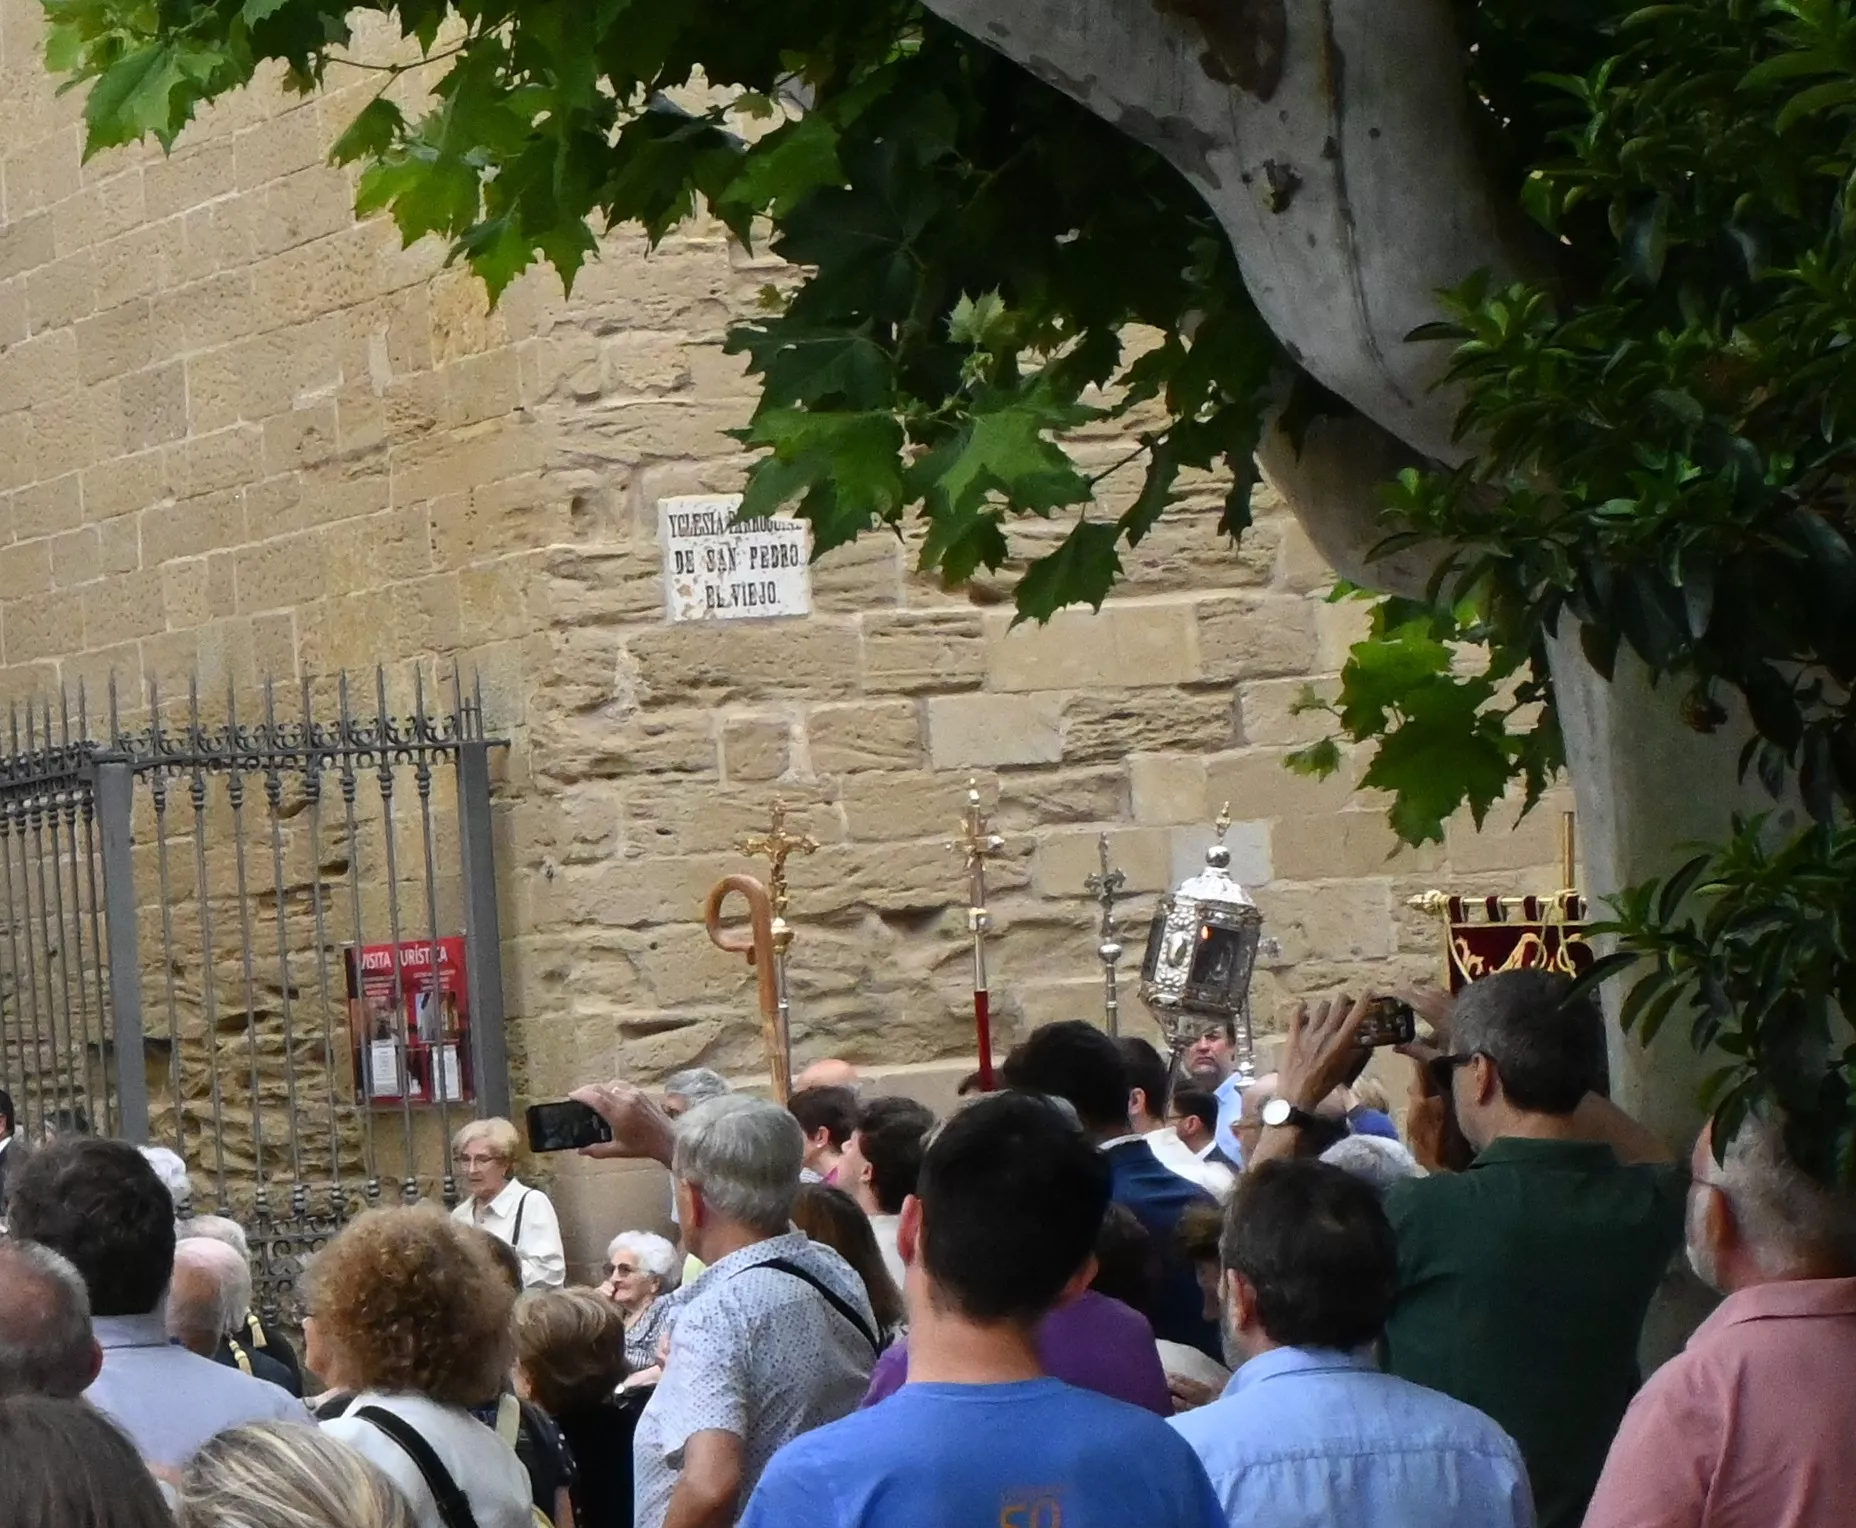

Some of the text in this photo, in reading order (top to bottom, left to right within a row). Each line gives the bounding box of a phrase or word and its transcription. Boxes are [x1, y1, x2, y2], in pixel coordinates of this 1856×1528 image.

[675, 544, 799, 575] DE SAN PEDRO
[705, 585, 724, 609] EL
